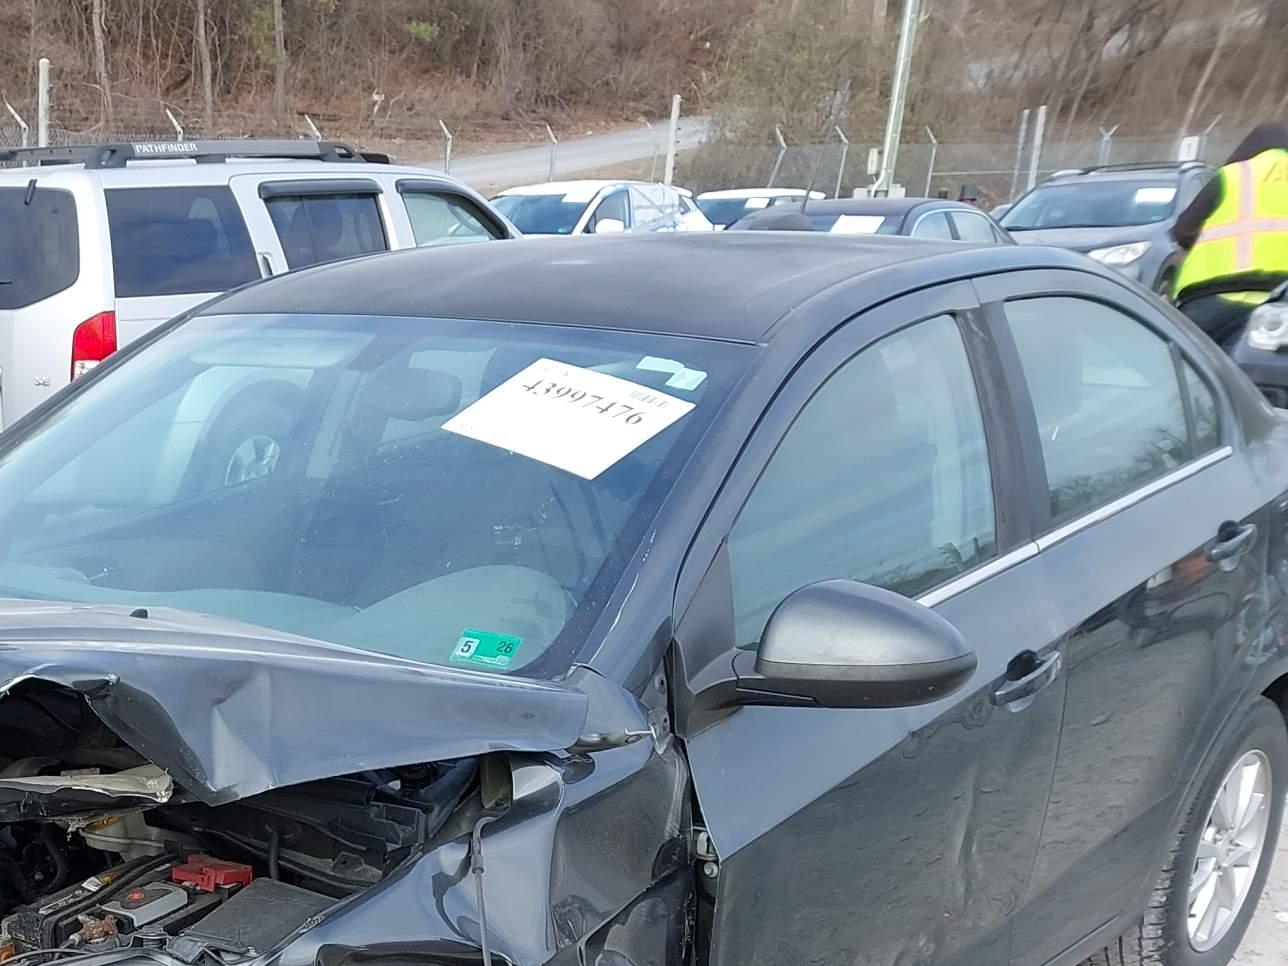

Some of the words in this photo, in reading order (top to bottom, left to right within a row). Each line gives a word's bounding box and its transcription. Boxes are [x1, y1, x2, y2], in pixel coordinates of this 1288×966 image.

[134, 142, 199, 154] PATHFINDER
[34, 376, 51, 387] SE
[522, 378, 644, 425] 43997476
[461, 640, 474, 654] 5
